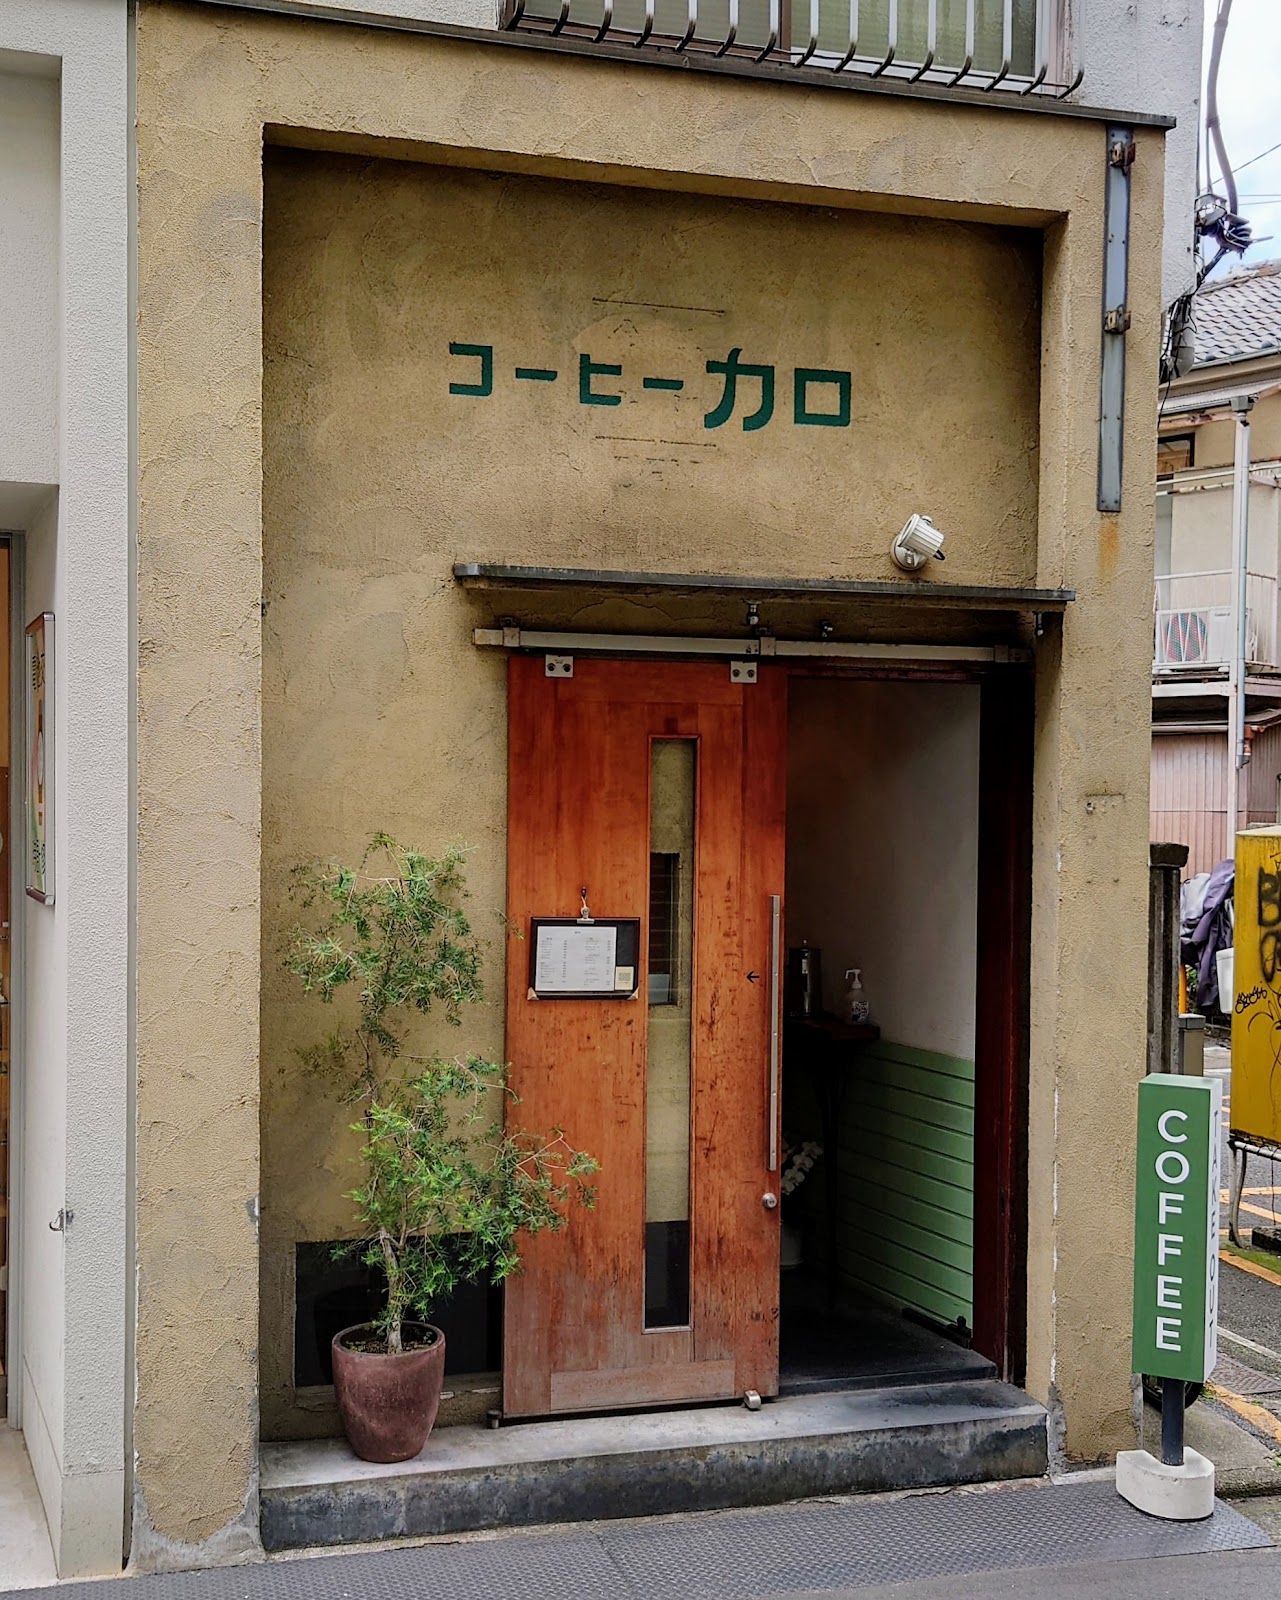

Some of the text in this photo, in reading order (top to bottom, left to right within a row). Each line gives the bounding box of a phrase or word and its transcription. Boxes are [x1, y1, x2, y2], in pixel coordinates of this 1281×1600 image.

[449, 343, 852, 432] コーヒーカロ
[1155, 1109, 1190, 1352] COFFEE
[1208, 1109, 1219, 1348] TAKE OUT
